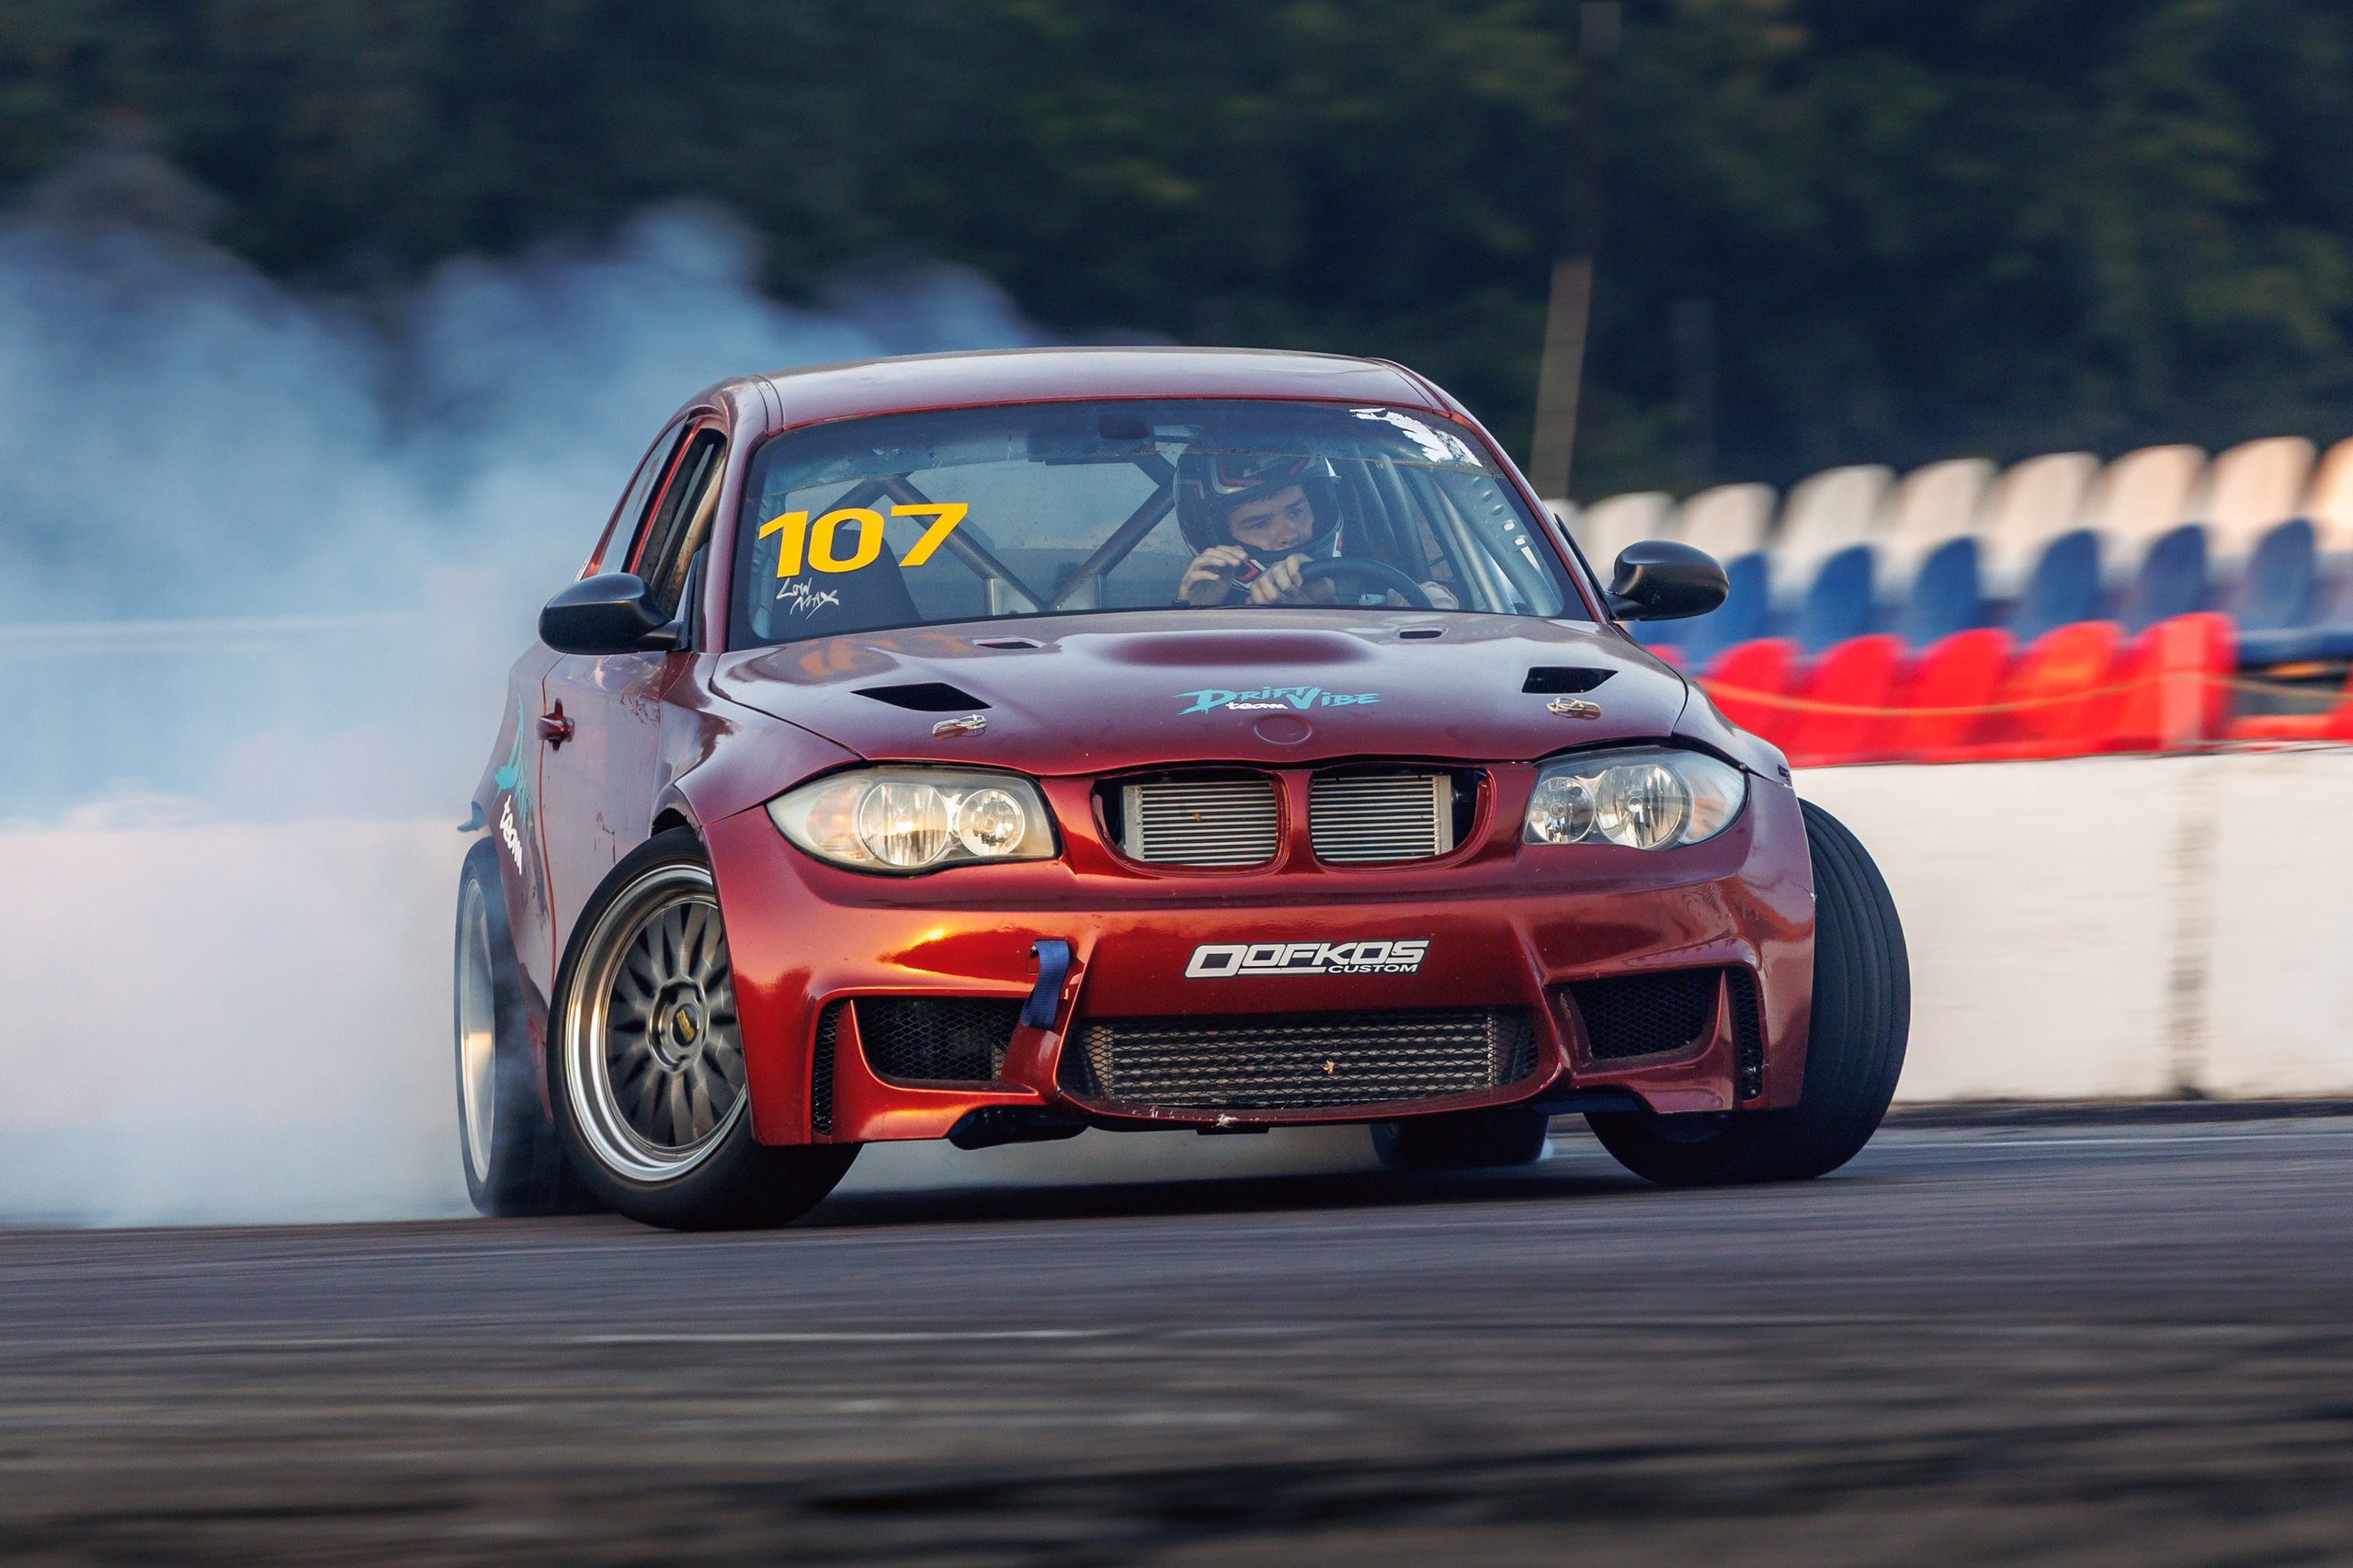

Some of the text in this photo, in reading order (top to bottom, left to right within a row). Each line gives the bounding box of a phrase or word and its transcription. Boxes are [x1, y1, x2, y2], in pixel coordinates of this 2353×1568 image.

[758, 503, 968, 578] 107
[1225, 701, 1289, 710] team
[1327, 963, 1419, 974] CUSTOM
